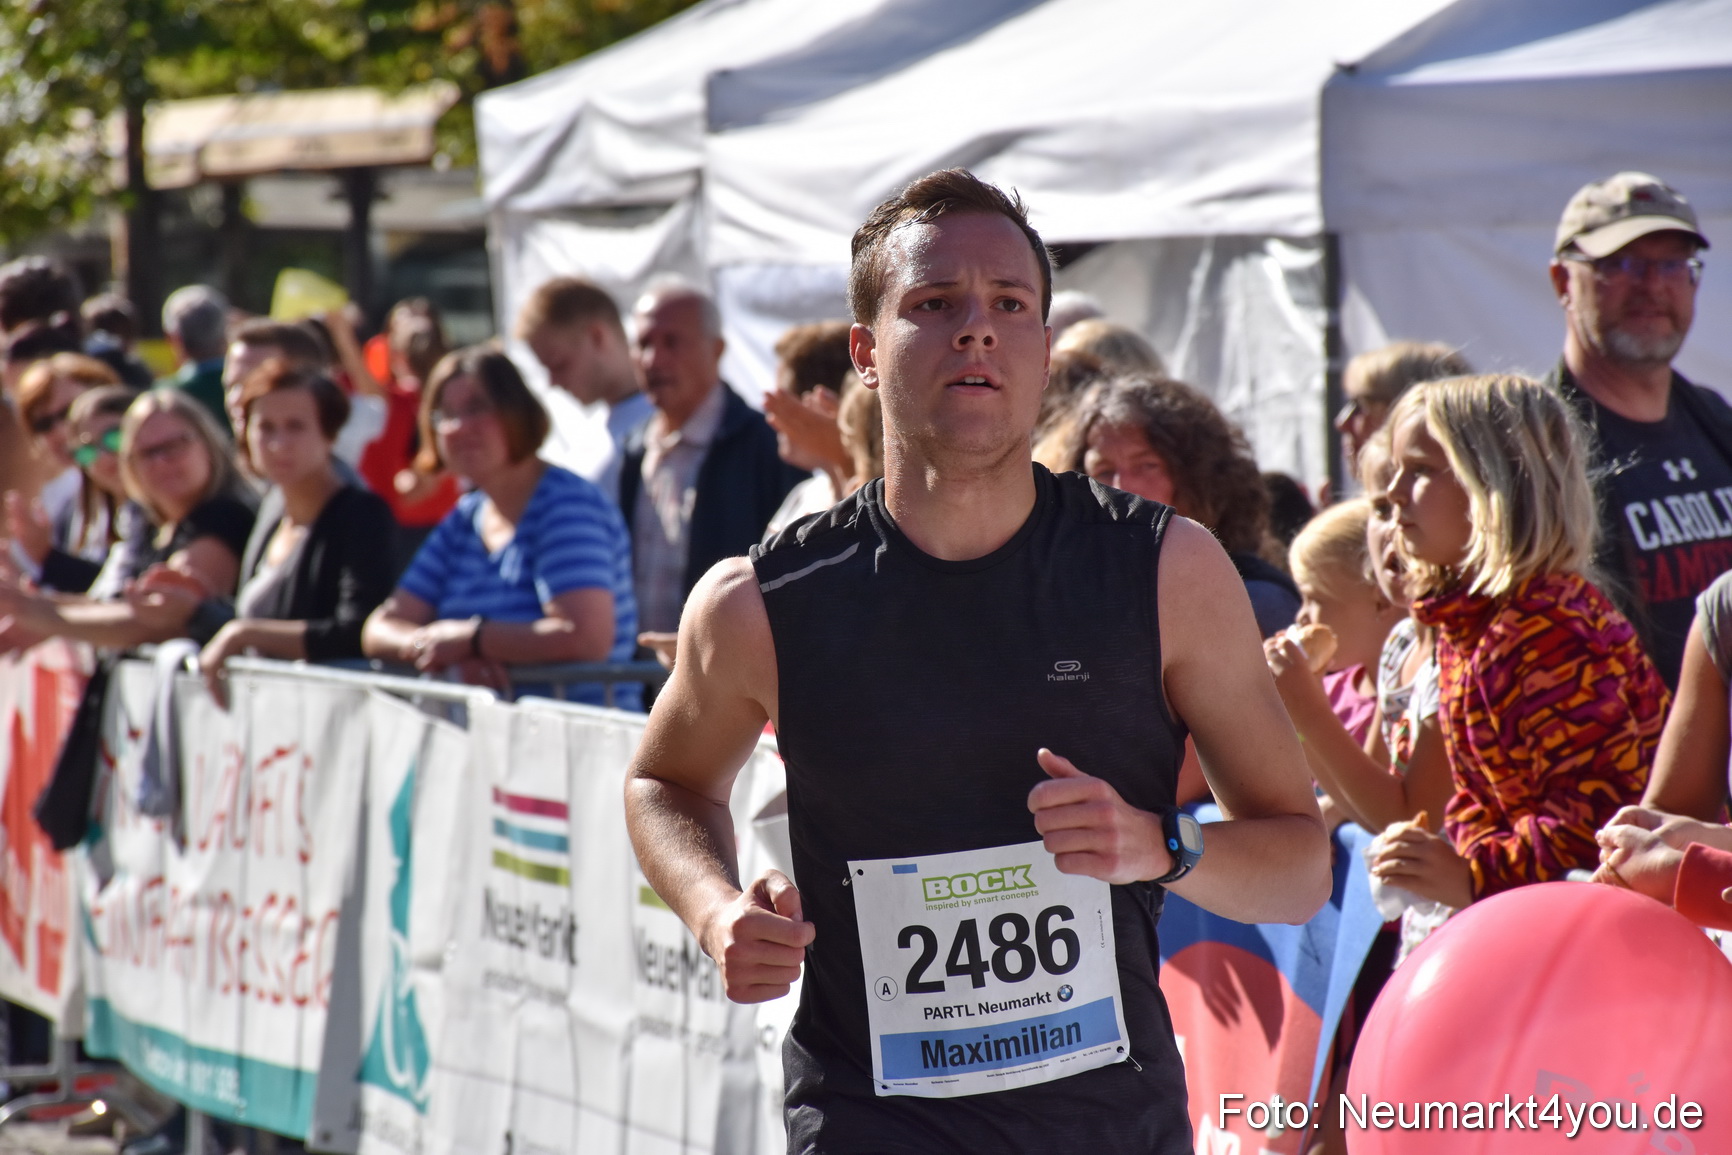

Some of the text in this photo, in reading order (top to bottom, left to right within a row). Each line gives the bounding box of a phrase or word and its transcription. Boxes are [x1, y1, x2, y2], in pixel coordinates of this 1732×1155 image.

[1625, 486, 1732, 550] CAROLI
[1047, 672, 1090, 682] Kalenji
[922, 864, 1036, 902] BOCK
[925, 889, 1039, 911] inspired by smart concepts
[897, 904, 1081, 995] 2486
[881, 983, 891, 996] A
[923, 991, 1052, 1020] PARTL Neumarkt
[920, 1021, 1082, 1069] Maximilian
